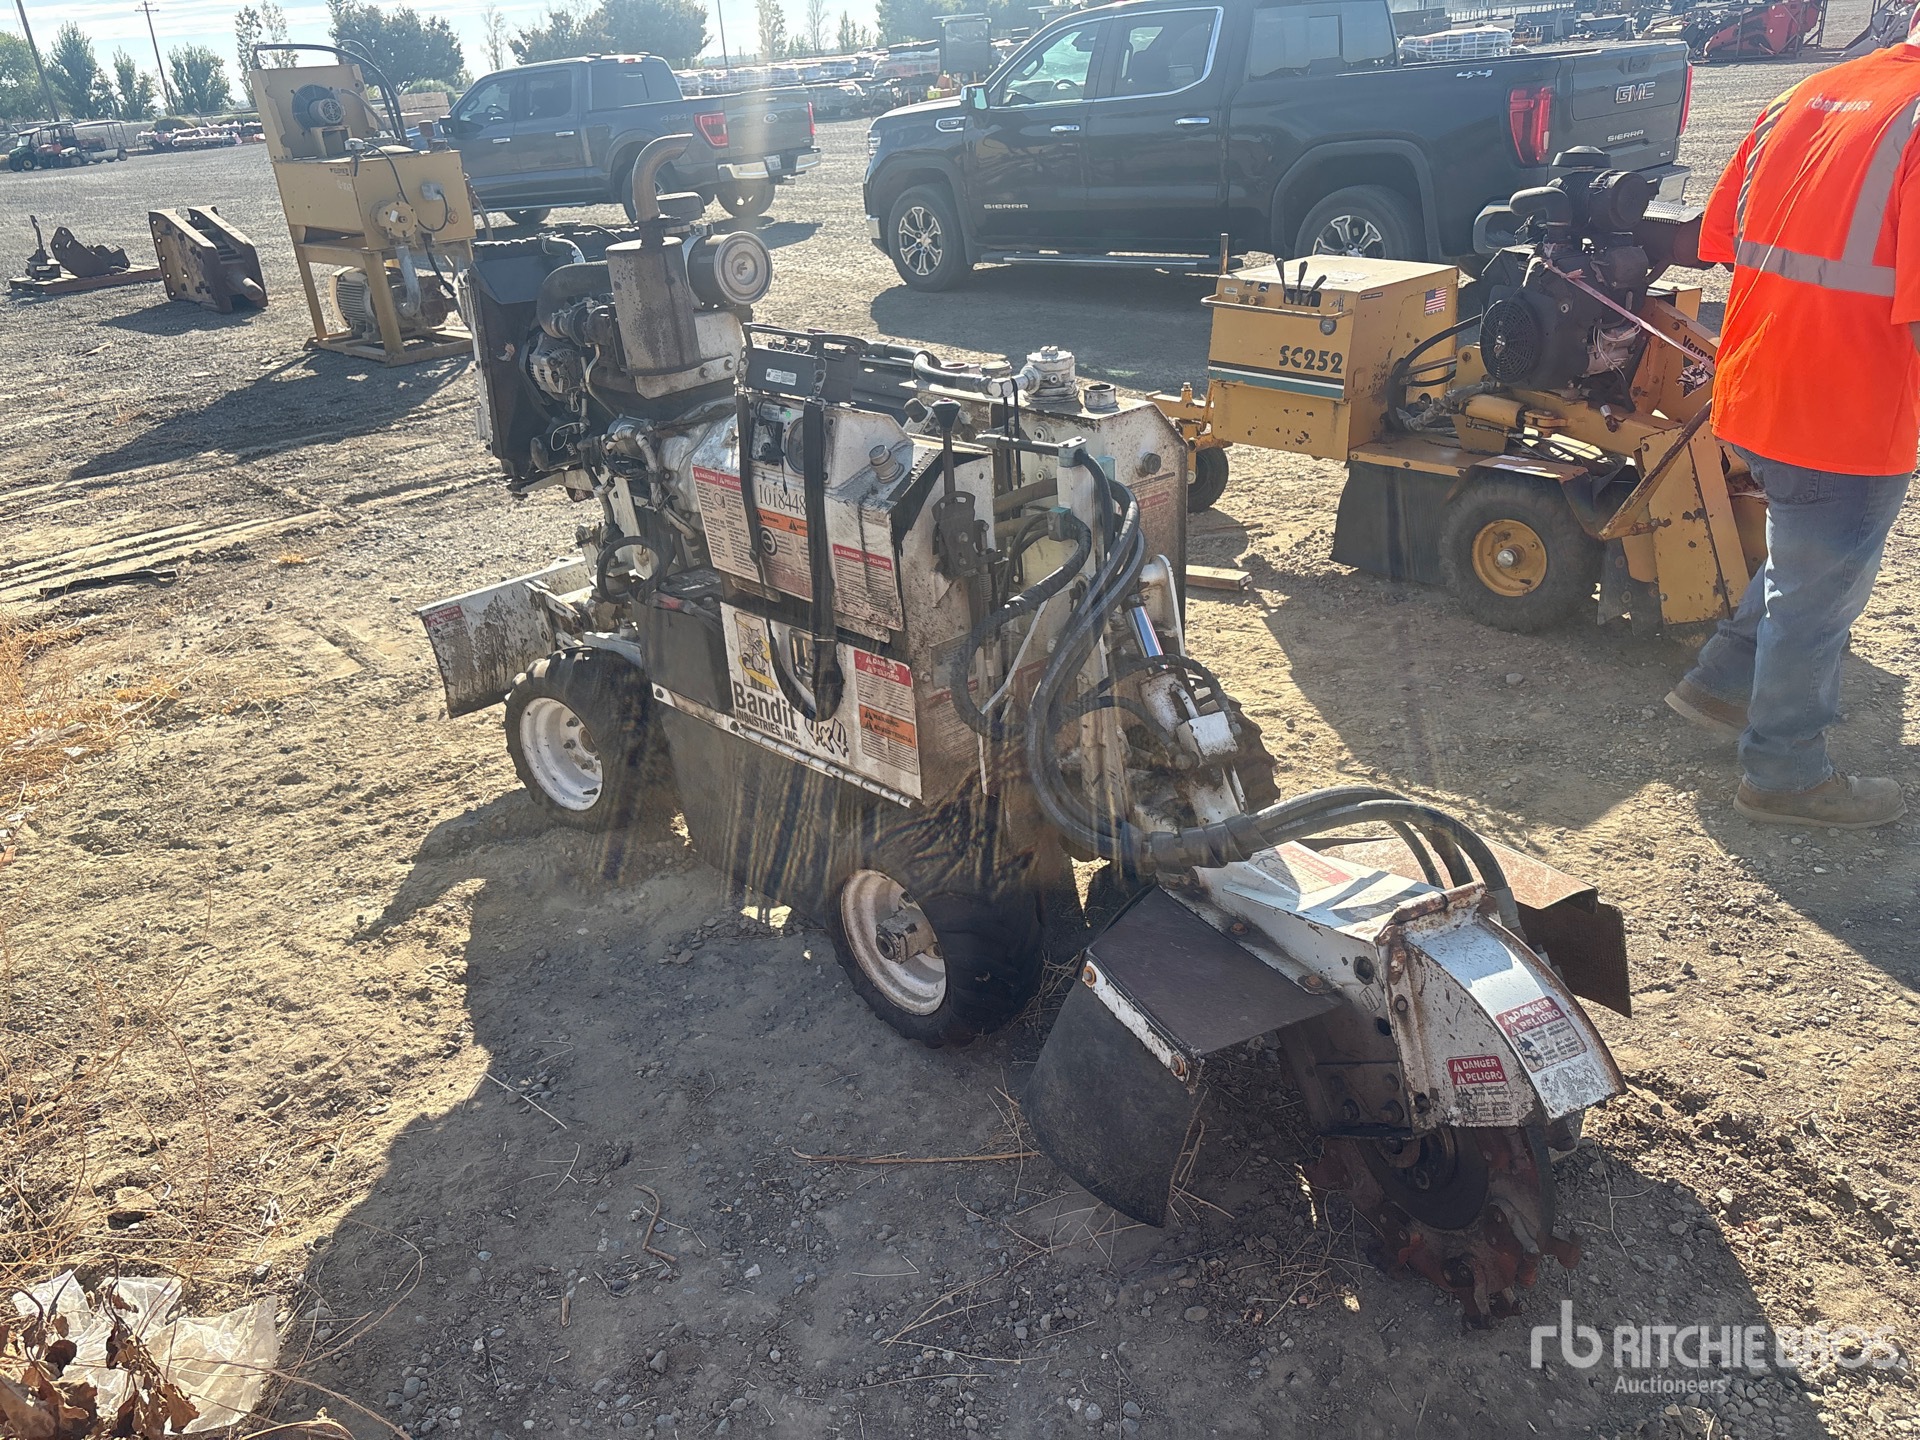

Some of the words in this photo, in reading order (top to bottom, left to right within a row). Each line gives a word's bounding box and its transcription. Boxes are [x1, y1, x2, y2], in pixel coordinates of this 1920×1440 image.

[1615, 81, 1656, 104] GMC
[1607, 129, 1644, 142] SIERRA
[1278, 344, 1343, 374] SC252
[1682, 334, 1715, 365] Verme
[758, 483, 807, 516] 1018448
[872, 657, 898, 672] DANER
[733, 681, 797, 731] Bandit
[736, 709, 784, 739] INDUSTRIES,
[785, 731, 801, 746] INC.
[1519, 1009, 1561, 1030] PELIGRO
[1461, 1058, 1498, 1070] DANGER
[1465, 1070, 1503, 1082] PELIGRO
